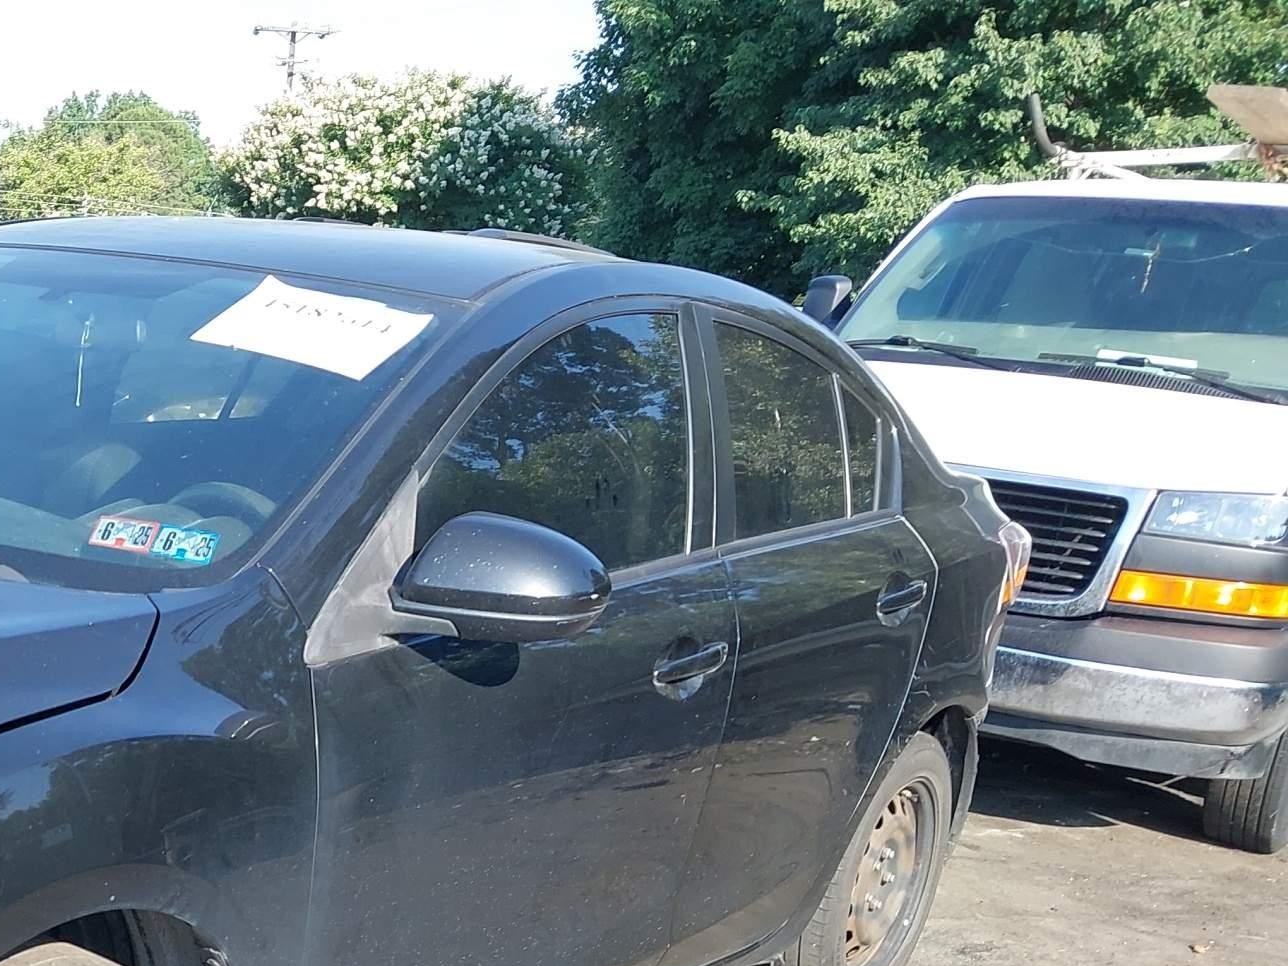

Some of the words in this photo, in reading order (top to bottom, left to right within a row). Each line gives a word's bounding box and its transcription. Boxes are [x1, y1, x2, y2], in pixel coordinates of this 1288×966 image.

[101, 521, 115, 541] 6
[133, 526, 153, 546] 25
[162, 531, 177, 551] 6
